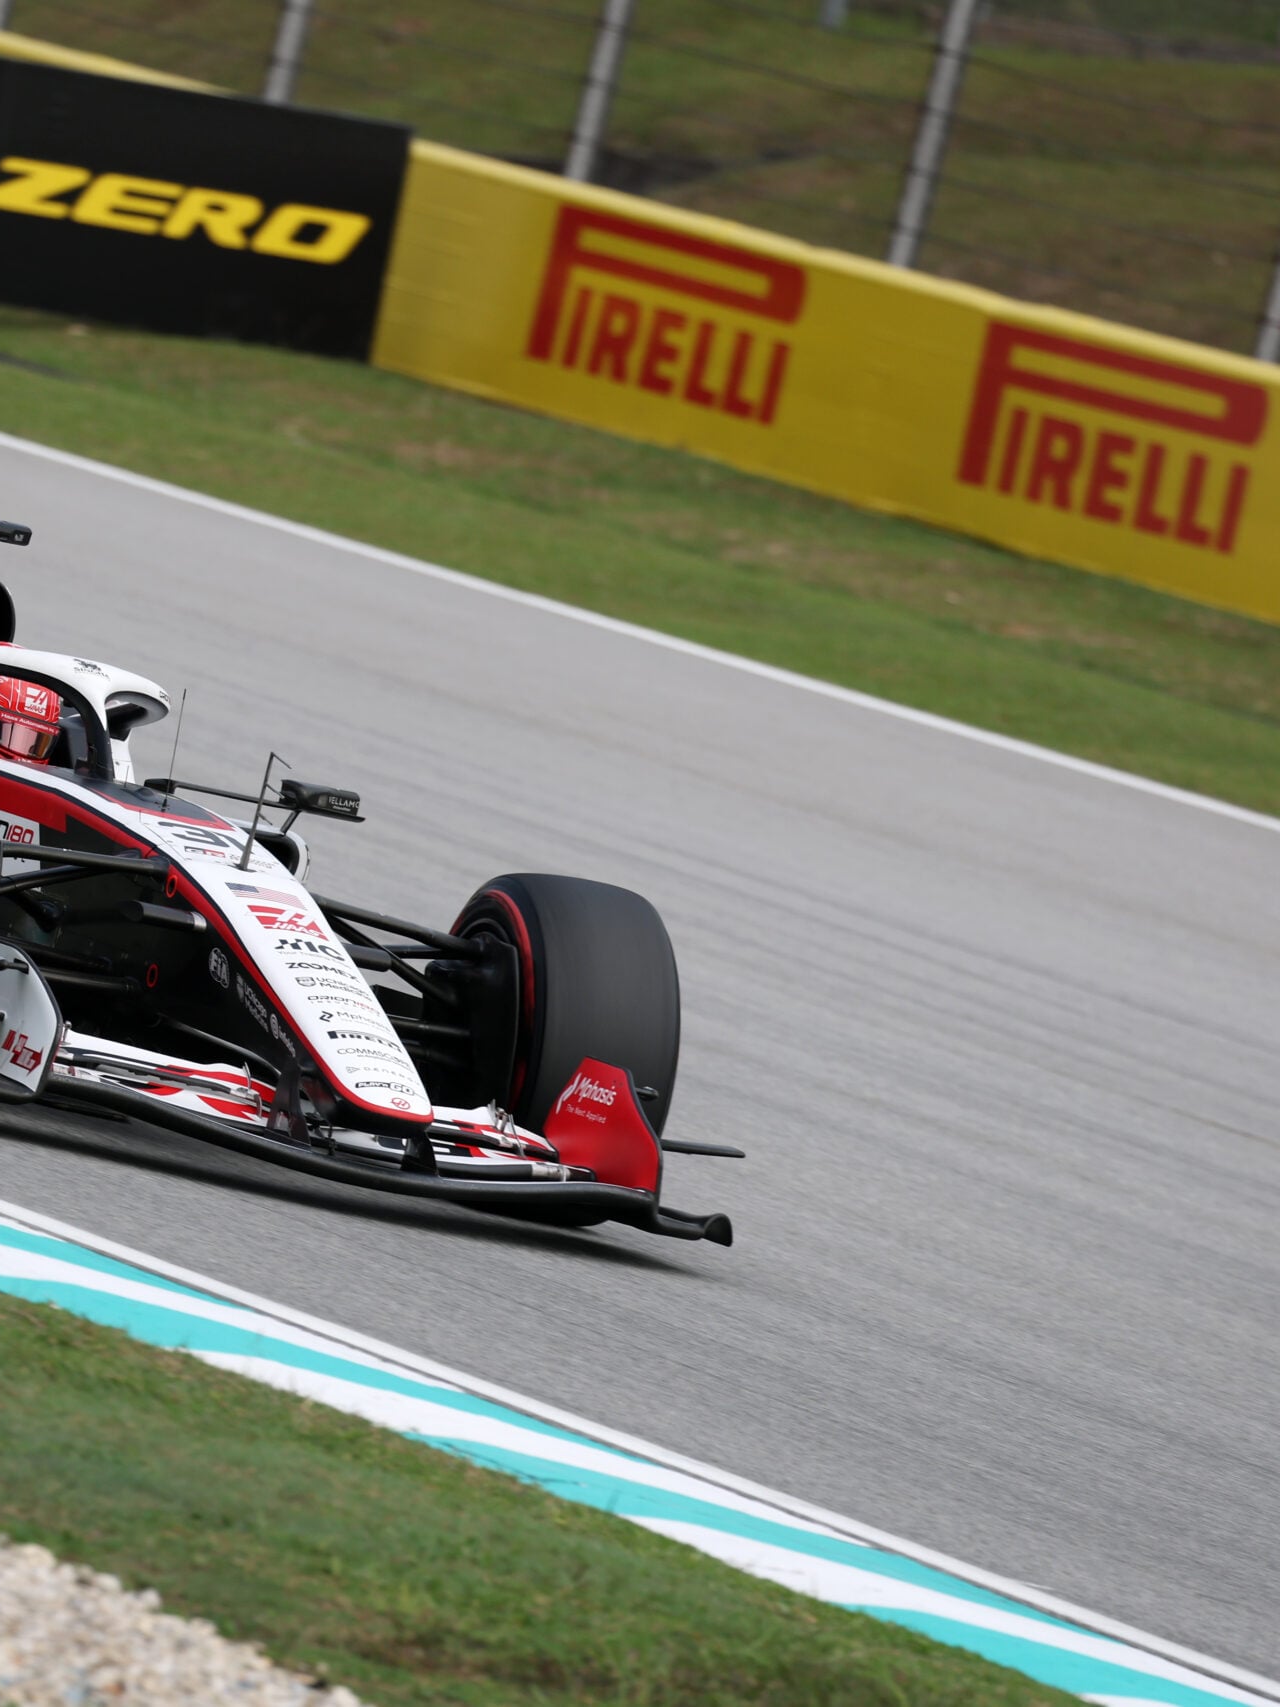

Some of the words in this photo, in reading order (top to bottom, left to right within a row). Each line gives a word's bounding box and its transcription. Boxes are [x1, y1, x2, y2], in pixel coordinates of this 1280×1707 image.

[526, 203, 807, 427] PIRELLI
[956, 319, 1271, 557] PIRELLI
[285, 961, 361, 984] ZOOMEX
[574, 1076, 617, 1107] Mphasis
